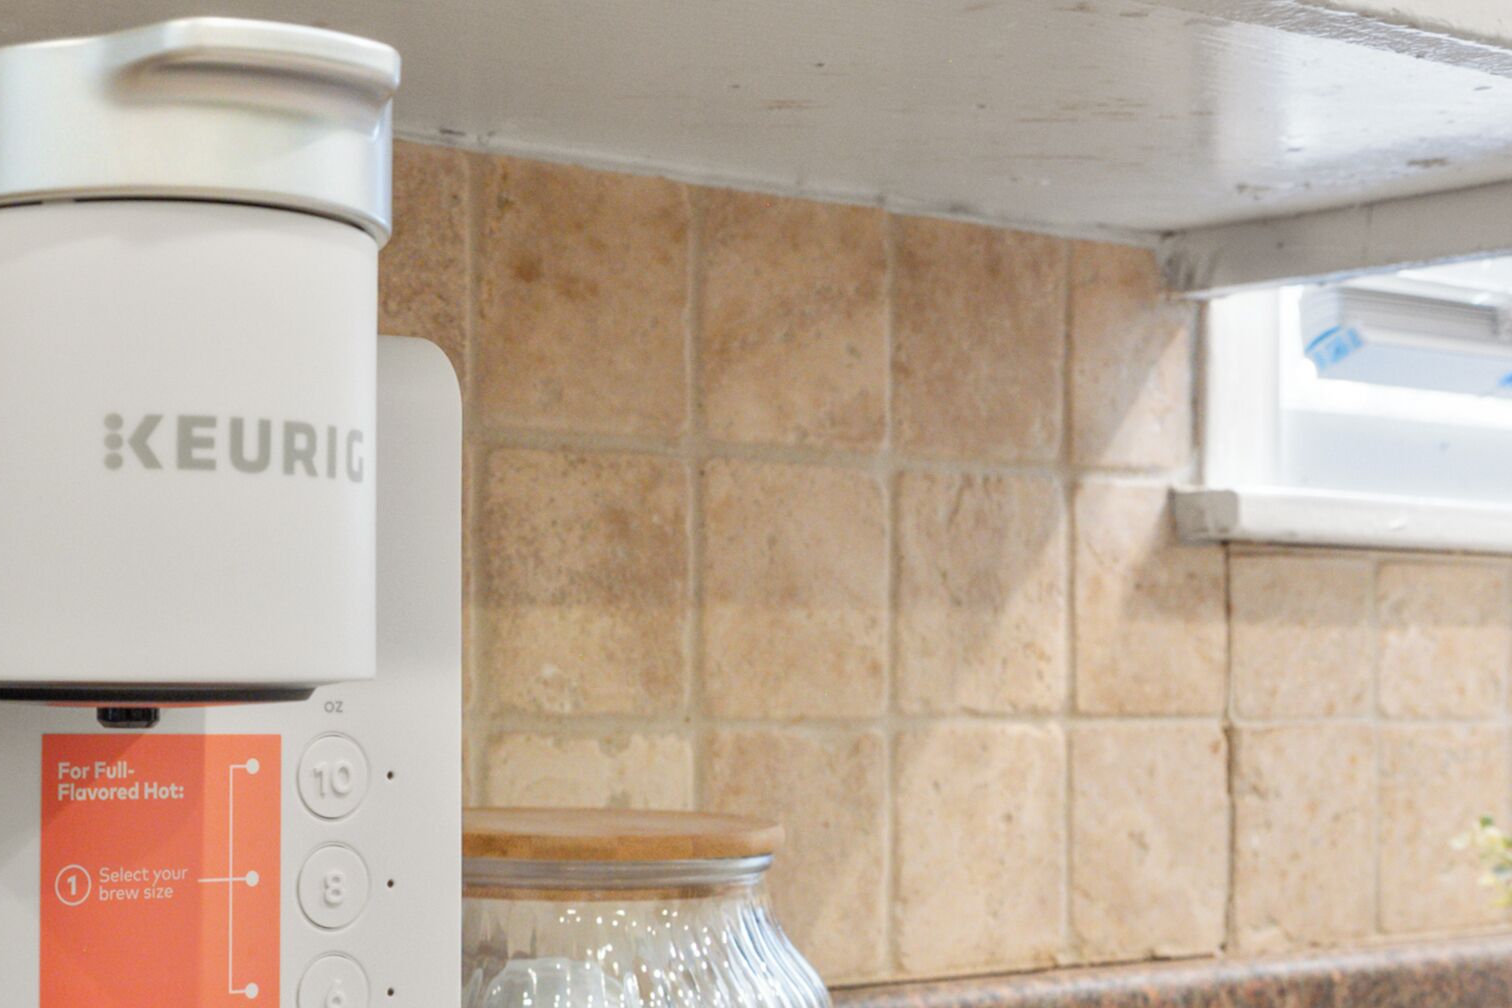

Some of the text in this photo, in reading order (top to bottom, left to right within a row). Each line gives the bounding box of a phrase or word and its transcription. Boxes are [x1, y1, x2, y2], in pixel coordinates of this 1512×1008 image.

[103, 412, 364, 483] KEURIG
[58, 761, 135, 779] For Full-
[313, 761, 351, 798] 10
[58, 782, 184, 800] Flavored Hot:
[67, 875, 77, 896] 1
[99, 867, 188, 887] Select your
[99, 885, 174, 900] brew size
[324, 870, 345, 905] 8
